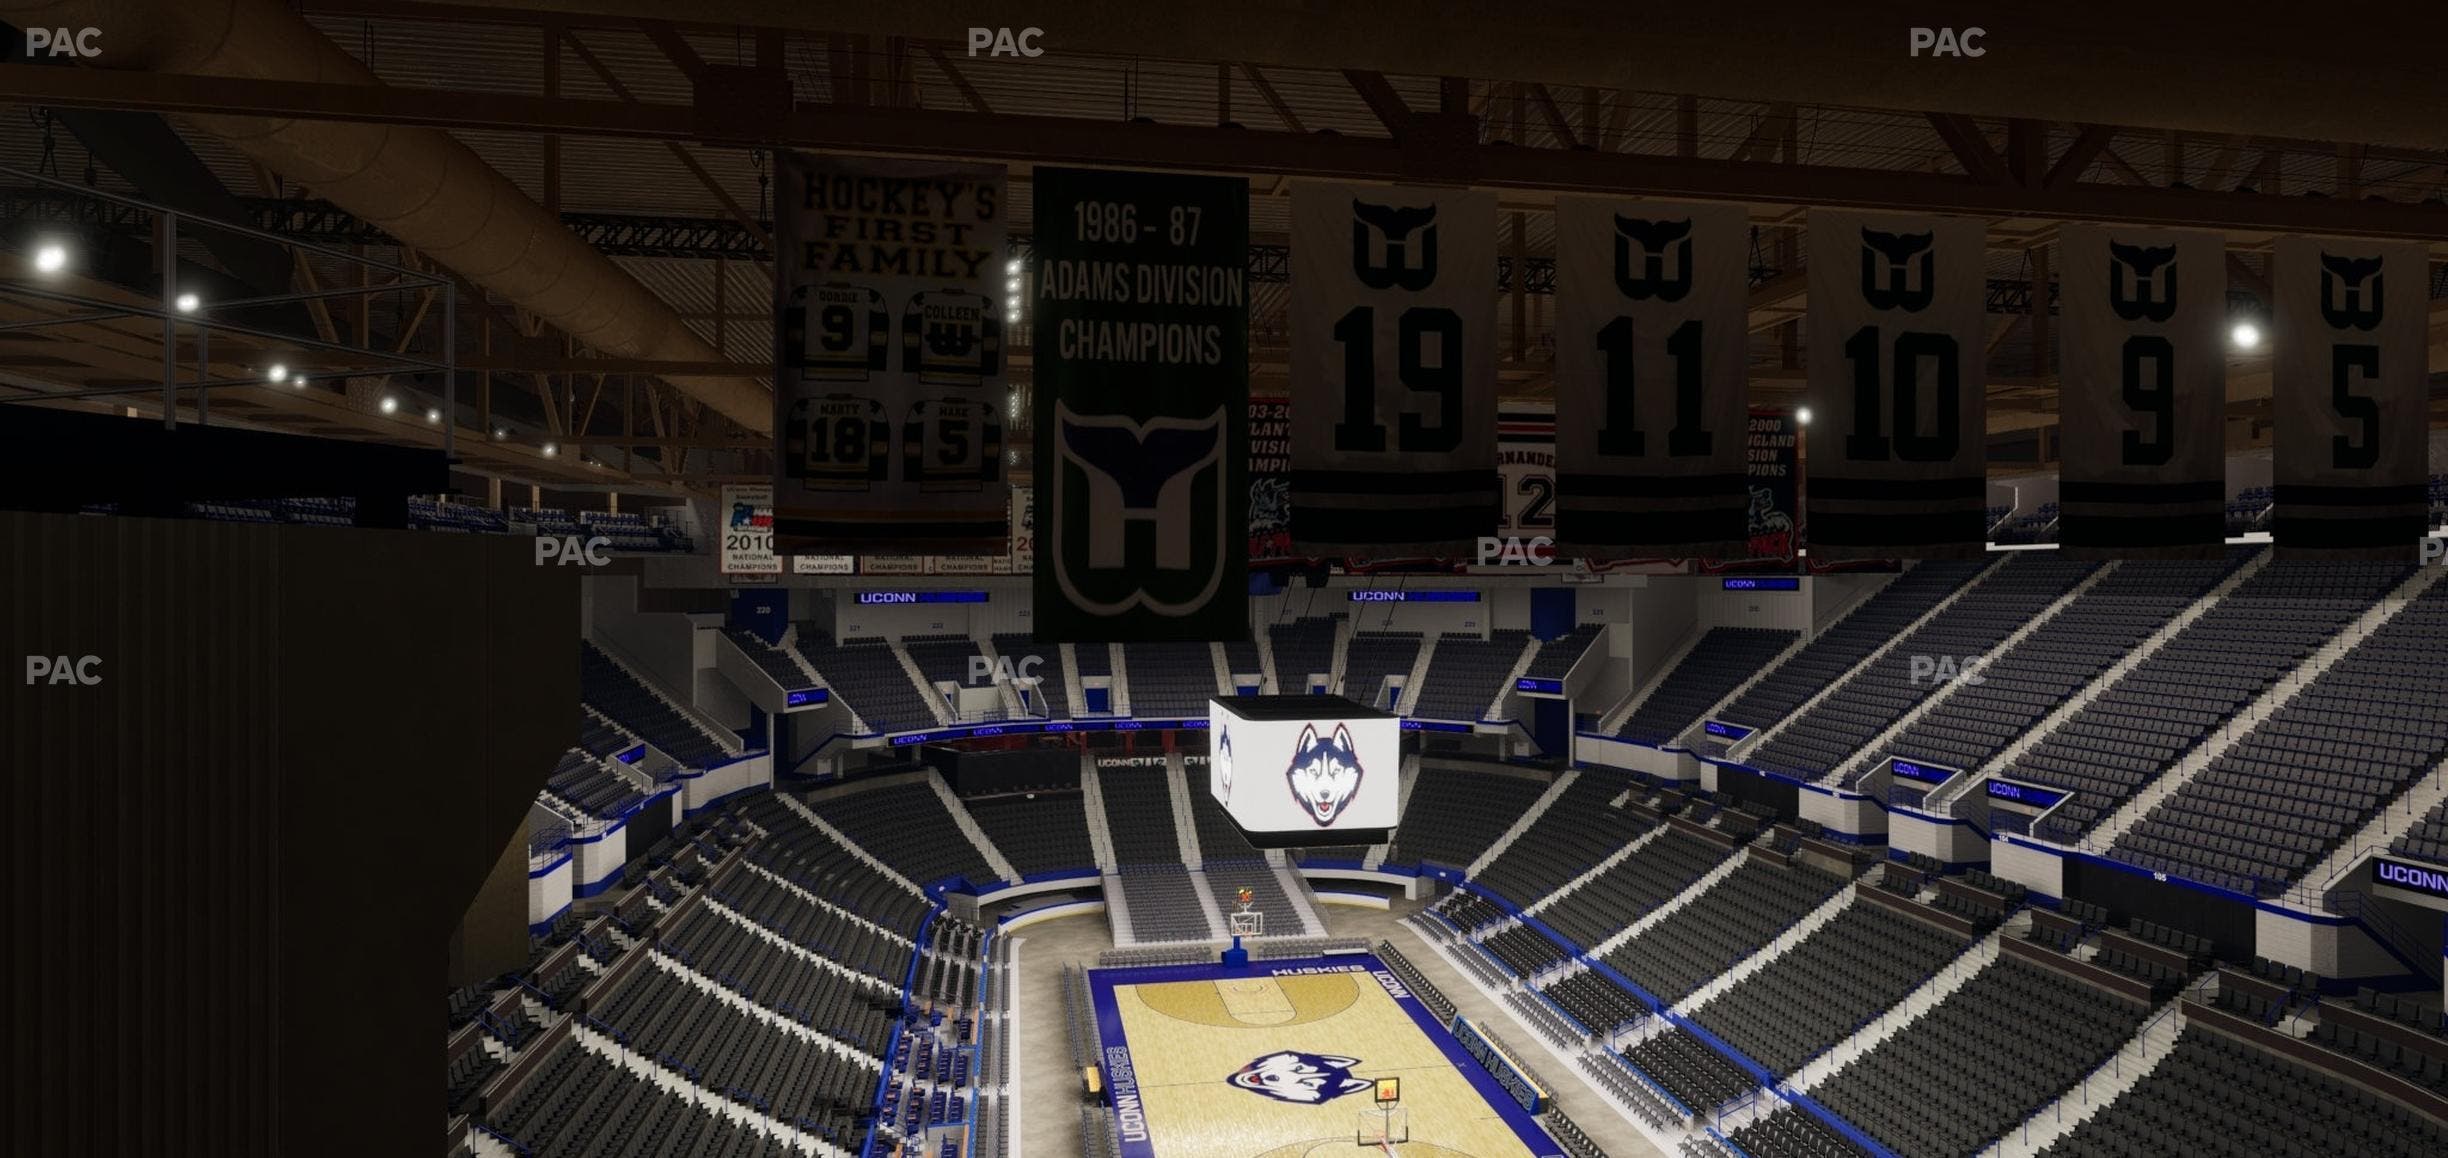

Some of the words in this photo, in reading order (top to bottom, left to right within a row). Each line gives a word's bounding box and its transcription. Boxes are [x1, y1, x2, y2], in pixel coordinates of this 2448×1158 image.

[805, 172, 995, 219] HOCKEY'S
[824, 214, 972, 245] FIRST
[1074, 201, 1137, 243] 1986
[1169, 206, 1201, 246] 87
[806, 242, 990, 278] FAMILY
[1040, 259, 1130, 302] ADAMS
[1137, 264, 1242, 307] DIVISION
[822, 306, 853, 350] 9
[925, 305, 980, 321] COLLEEN
[1059, 318, 1221, 365] CHAMPIONS
[1334, 307, 1462, 451] 19
[1597, 316, 1712, 456] 11
[1846, 326, 1959, 461] 10
[2123, 336, 2174, 466] 9
[2333, 344, 2380, 469] 5
[812, 417, 865, 462] 18
[939, 420, 968, 465] 5
[860, 593, 916, 603] UCONN
[1353, 592, 1405, 601] UCONN
[893, 734, 928, 746] UCONN
[972, 727, 1003, 737] UCONN
[1988, 781, 2021, 799] UCONN
[2380, 862, 2448, 894] UCONN
[1272, 964, 1366, 977] HUSKIES
[1115, 1094, 1147, 1142] UCONN
